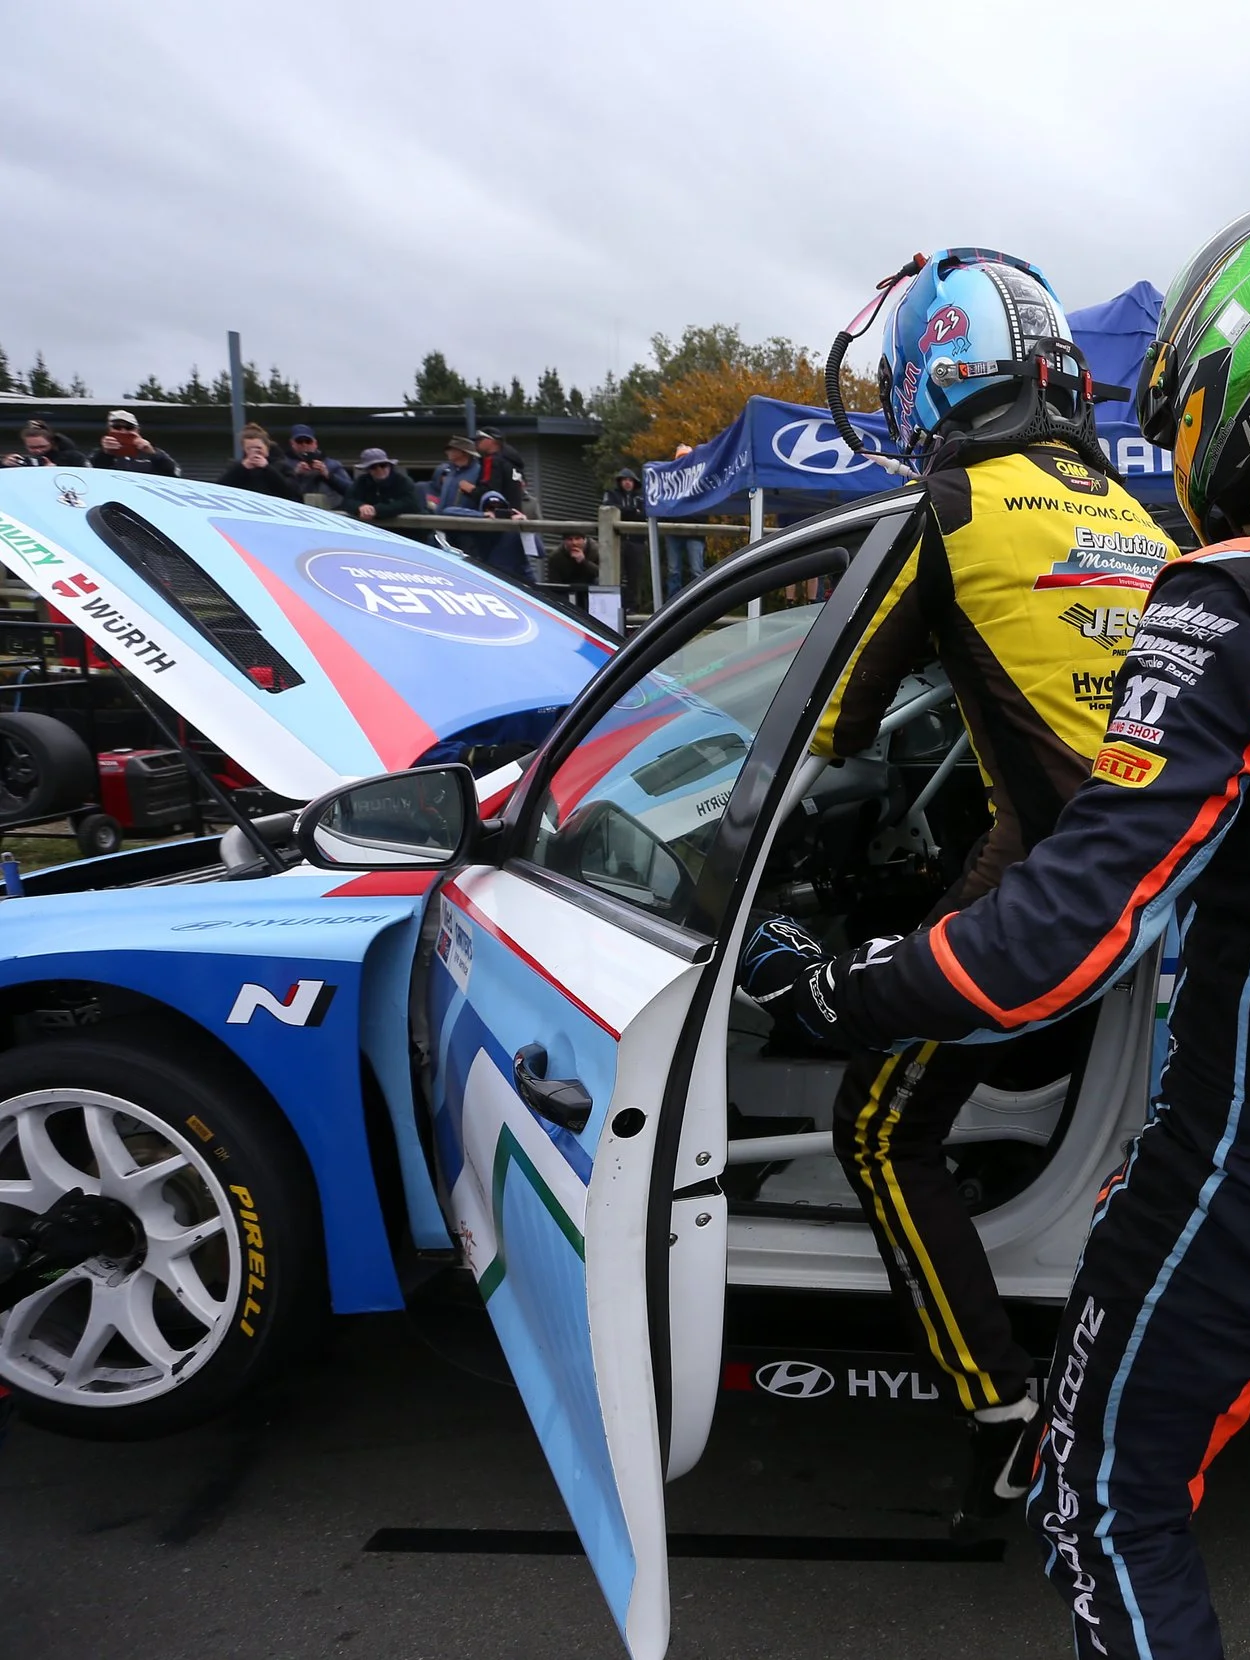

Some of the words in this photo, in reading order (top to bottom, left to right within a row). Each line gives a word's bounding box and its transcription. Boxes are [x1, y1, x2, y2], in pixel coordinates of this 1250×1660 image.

[933, 309, 960, 341] 23
[1055, 460, 1089, 479] OMP
[1075, 526, 1168, 560] Evolution
[1076, 551, 1159, 577] Motorsport
[353, 582, 520, 620] BAILEY
[81, 596, 177, 675] WÜRTH
[1165, 662, 1198, 687] Pads
[1127, 723, 1160, 742] SHOX
[231, 914, 391, 929] HYUNDAI
[229, 1184, 266, 1338] PIRELLI
